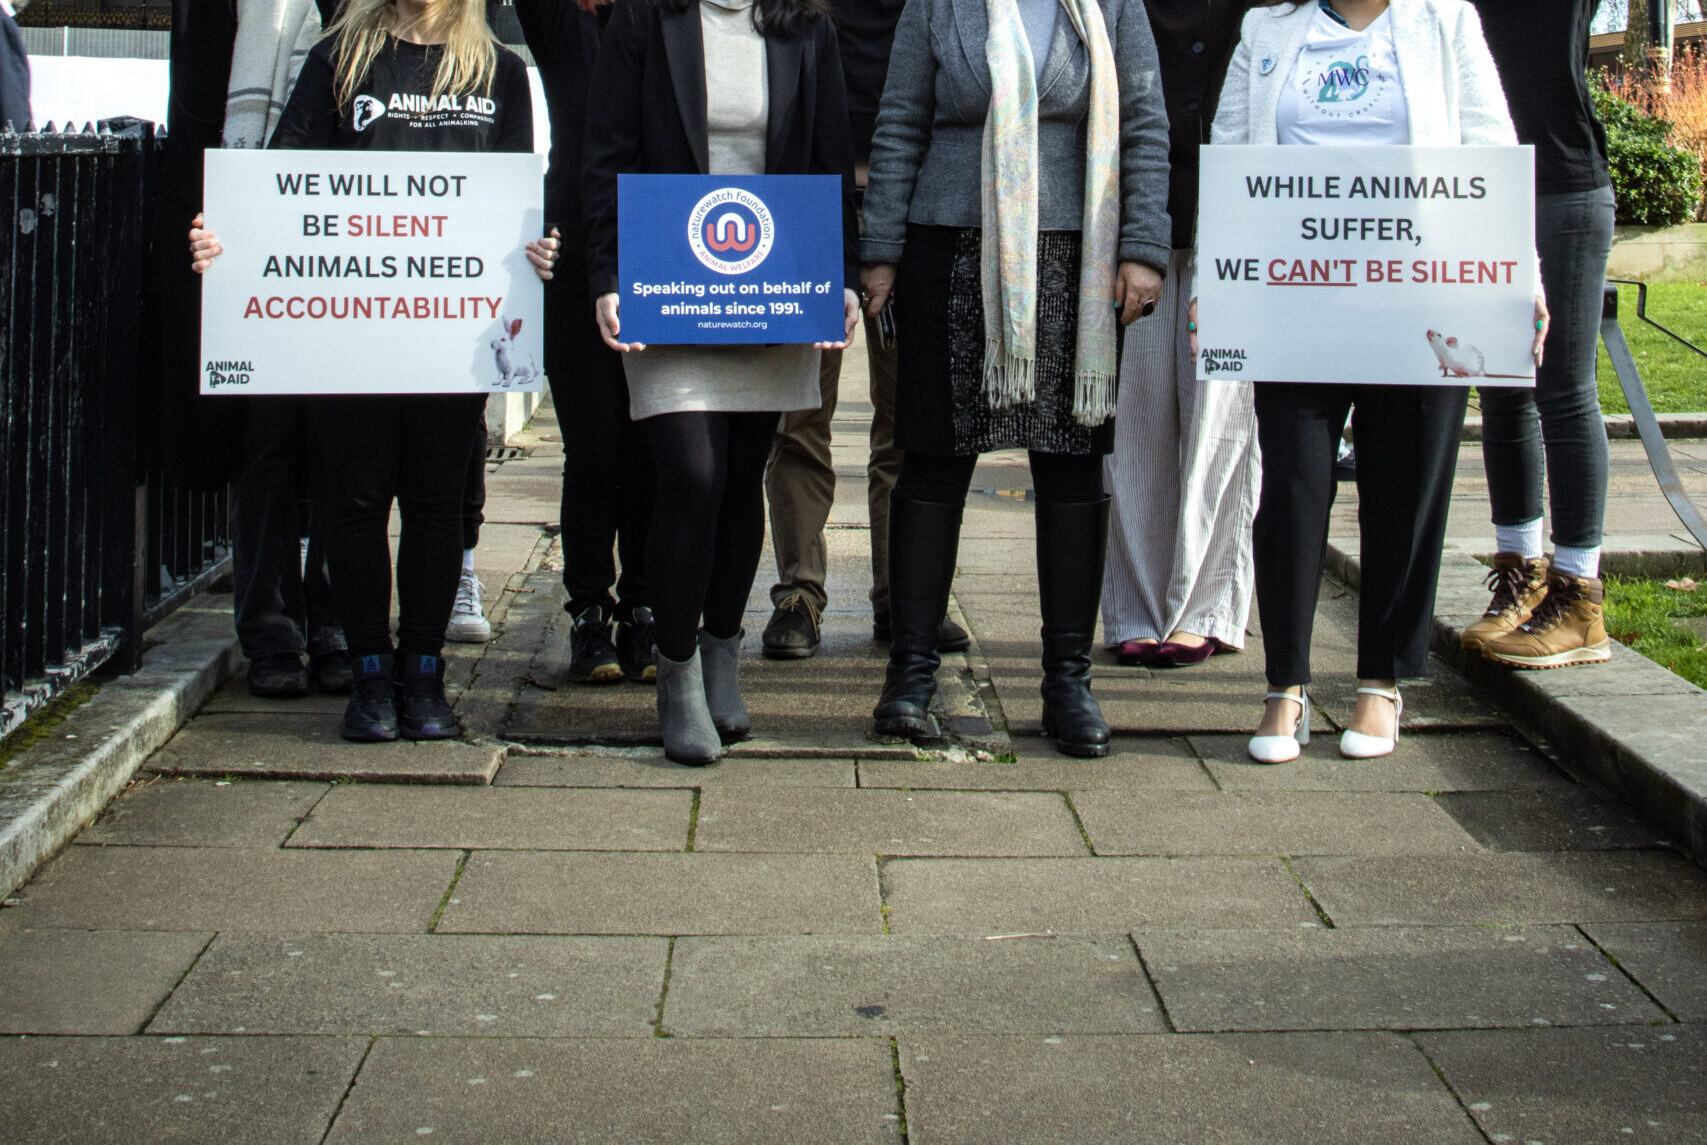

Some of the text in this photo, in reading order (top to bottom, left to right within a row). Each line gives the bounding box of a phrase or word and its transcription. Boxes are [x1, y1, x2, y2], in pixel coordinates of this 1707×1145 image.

[1318, 68, 1369, 86] MWC
[388, 93, 495, 114] ANIMAL AID
[276, 174, 466, 197] WE WILL NOT
[1246, 176, 1486, 199] WHILE ANIMALS
[692, 191, 770, 239] naturewatch foundation
[303, 215, 448, 237] BE SILENT
[1301, 218, 1421, 246] SUFFER,
[263, 256, 483, 278] ANIMALS NEED
[699, 250, 764, 271] ANIMAL WELFARE
[1216, 259, 1517, 286] WE CAN'T BE SILENT
[633, 281, 830, 297] Speaking out on behalf of
[244, 297, 502, 319] ACCOUNTABILITY
[661, 302, 803, 314] animals since 1991.
[698, 321, 767, 329] naturewatch.org
[1201, 348, 1247, 359] ANIMAL
[206, 359, 255, 372] ANIMAL
[1221, 362, 1243, 371] AID
[227, 374, 249, 384] AID
